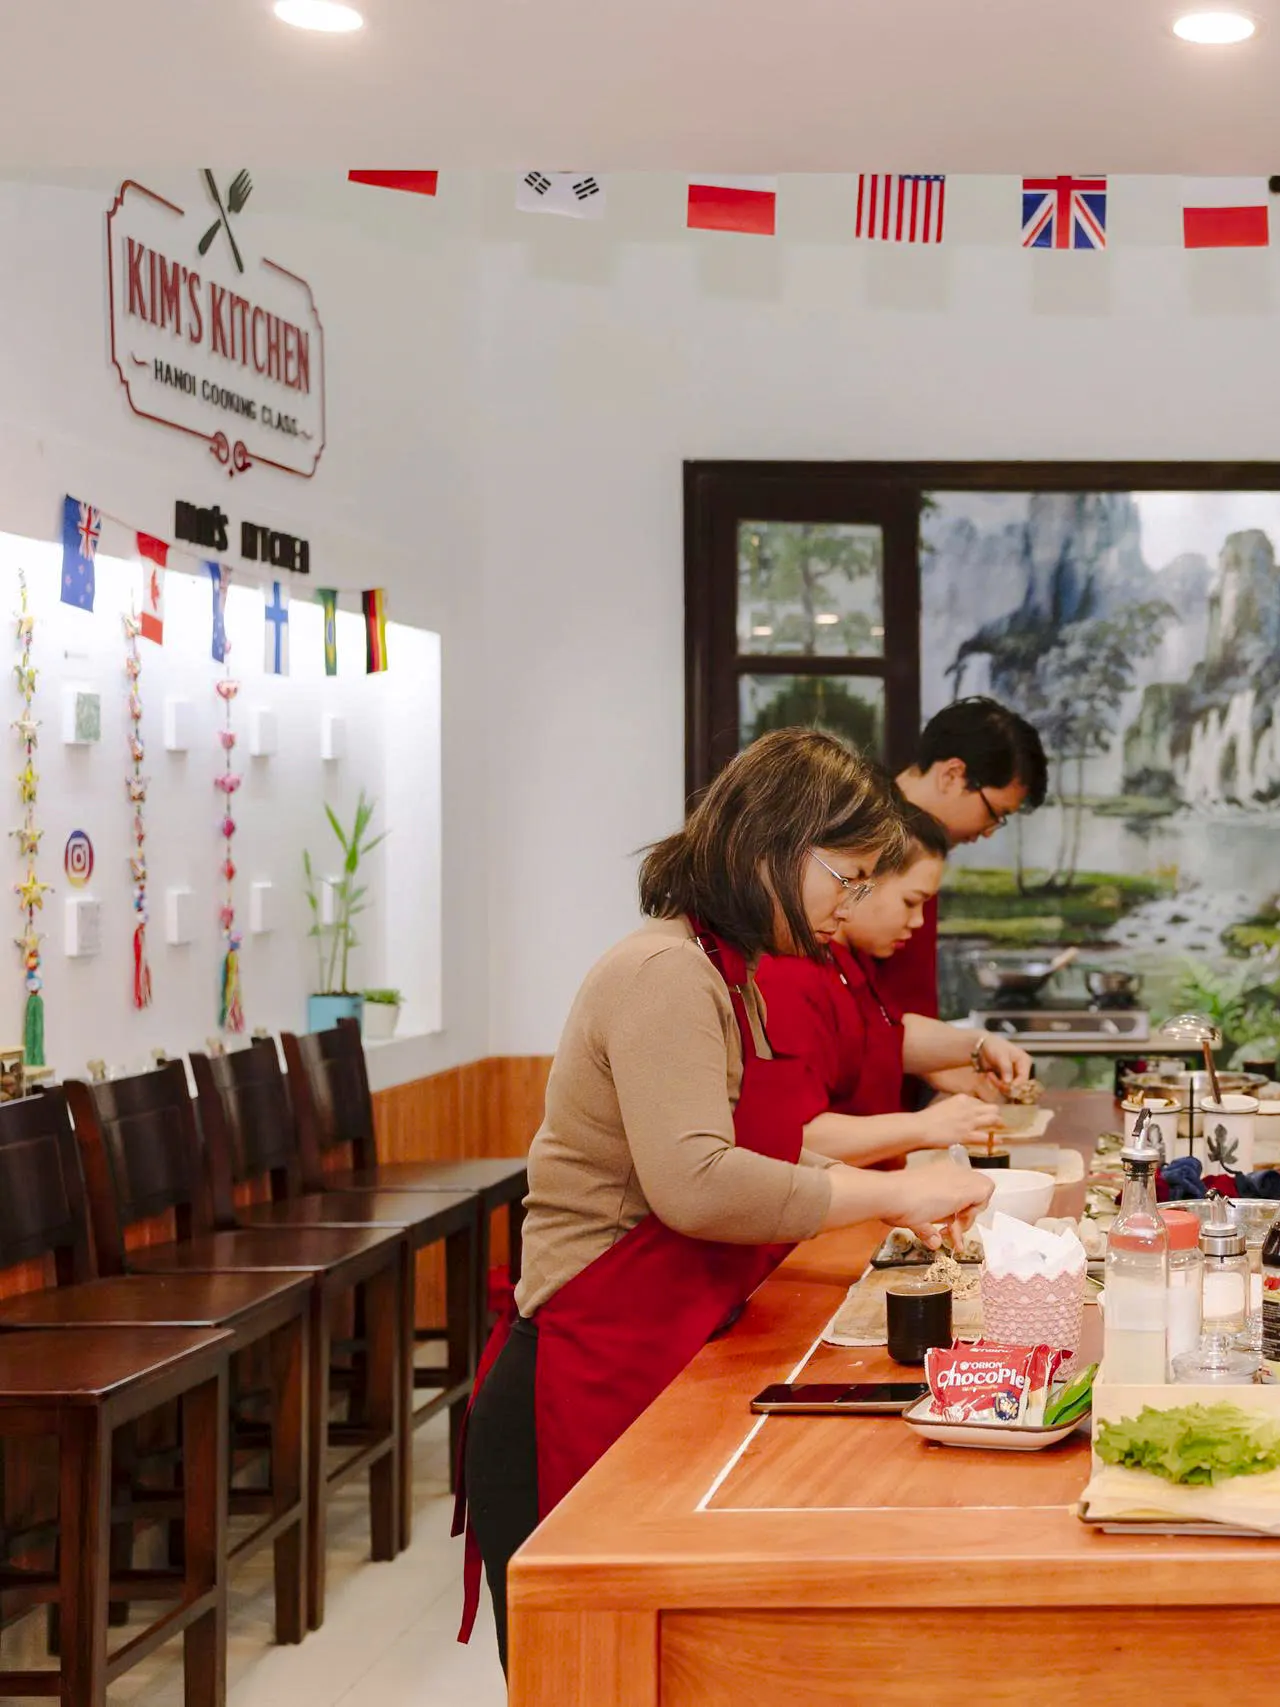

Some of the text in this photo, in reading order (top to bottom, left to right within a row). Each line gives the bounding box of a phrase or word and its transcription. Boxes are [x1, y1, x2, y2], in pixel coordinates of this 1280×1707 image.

[127, 236, 310, 394] KIM'S KITCHEN
[154, 358, 299, 437] HANOI COOKING CLASS
[970, 1361, 1003, 1369] ORION
